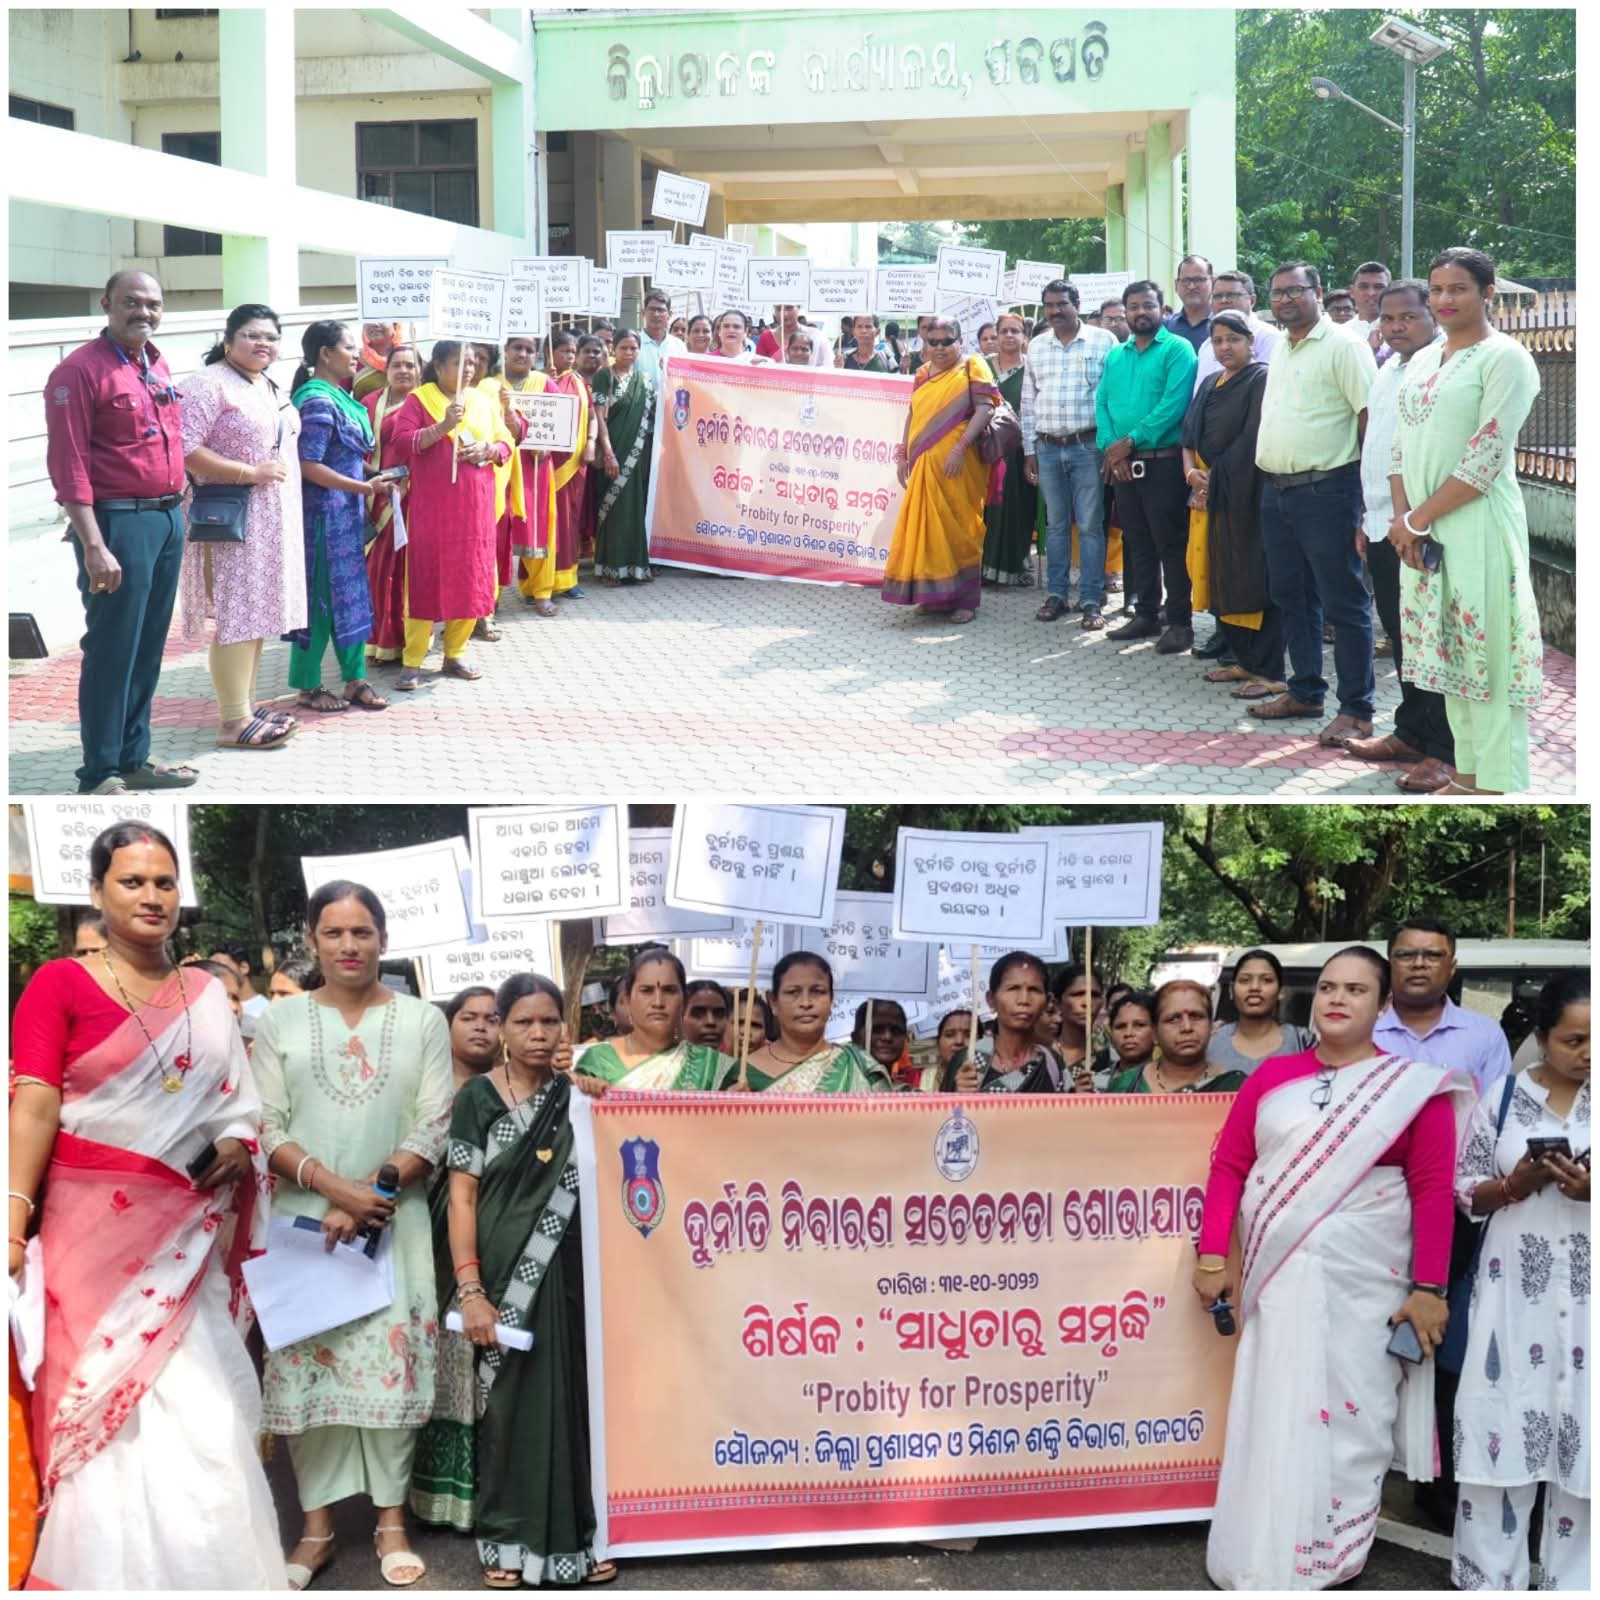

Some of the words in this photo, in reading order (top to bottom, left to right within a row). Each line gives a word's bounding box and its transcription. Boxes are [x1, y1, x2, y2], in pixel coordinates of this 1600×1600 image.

[984, 20, 1109, 85] ଗଜପତି
[696, 412, 730, 448] ଦୁର୍ନୀତି
[733, 415, 779, 450] ନିବାରଣ
[735, 503, 780, 527] “Probity
[783, 509, 799, 526] for
[802, 513, 869, 538] Prosperity”
[683, 1182, 771, 1265] ଦୁର୍ନୀତି
[781, 1180, 893, 1247] ନିବାରଣ
[903, 1190, 1053, 1244] ସଚେତନତା
[1063, 1185, 1206, 1242] ଶୋଭାଯାତ୍ର
[742, 1302, 841, 1357] ଶିର୍ଷକ
[879, 1307, 1047, 1361] “ସାଧୁତାରୁ
[1058, 1290, 1166, 1358] ସମୃଦ୍ଧି”
[802, 1380, 910, 1419] “Probity
[920, 1377, 956, 1409] for
[965, 1369, 1109, 1412] Prosperity”
[815, 1430, 860, 1471] ଜିଲ୍ଲା
[866, 1432, 942, 1468] ପ୍ରଶାସନ
[948, 1431, 962, 1457] ଓ
[968, 1422, 1020, 1455] ମିଶନ
[1025, 1419, 1061, 1460] ଶକ୍ତି
[1066, 1417, 1130, 1450] ବିଭାଗ,
[1135, 1409, 1204, 1445] ଗଜପତି
